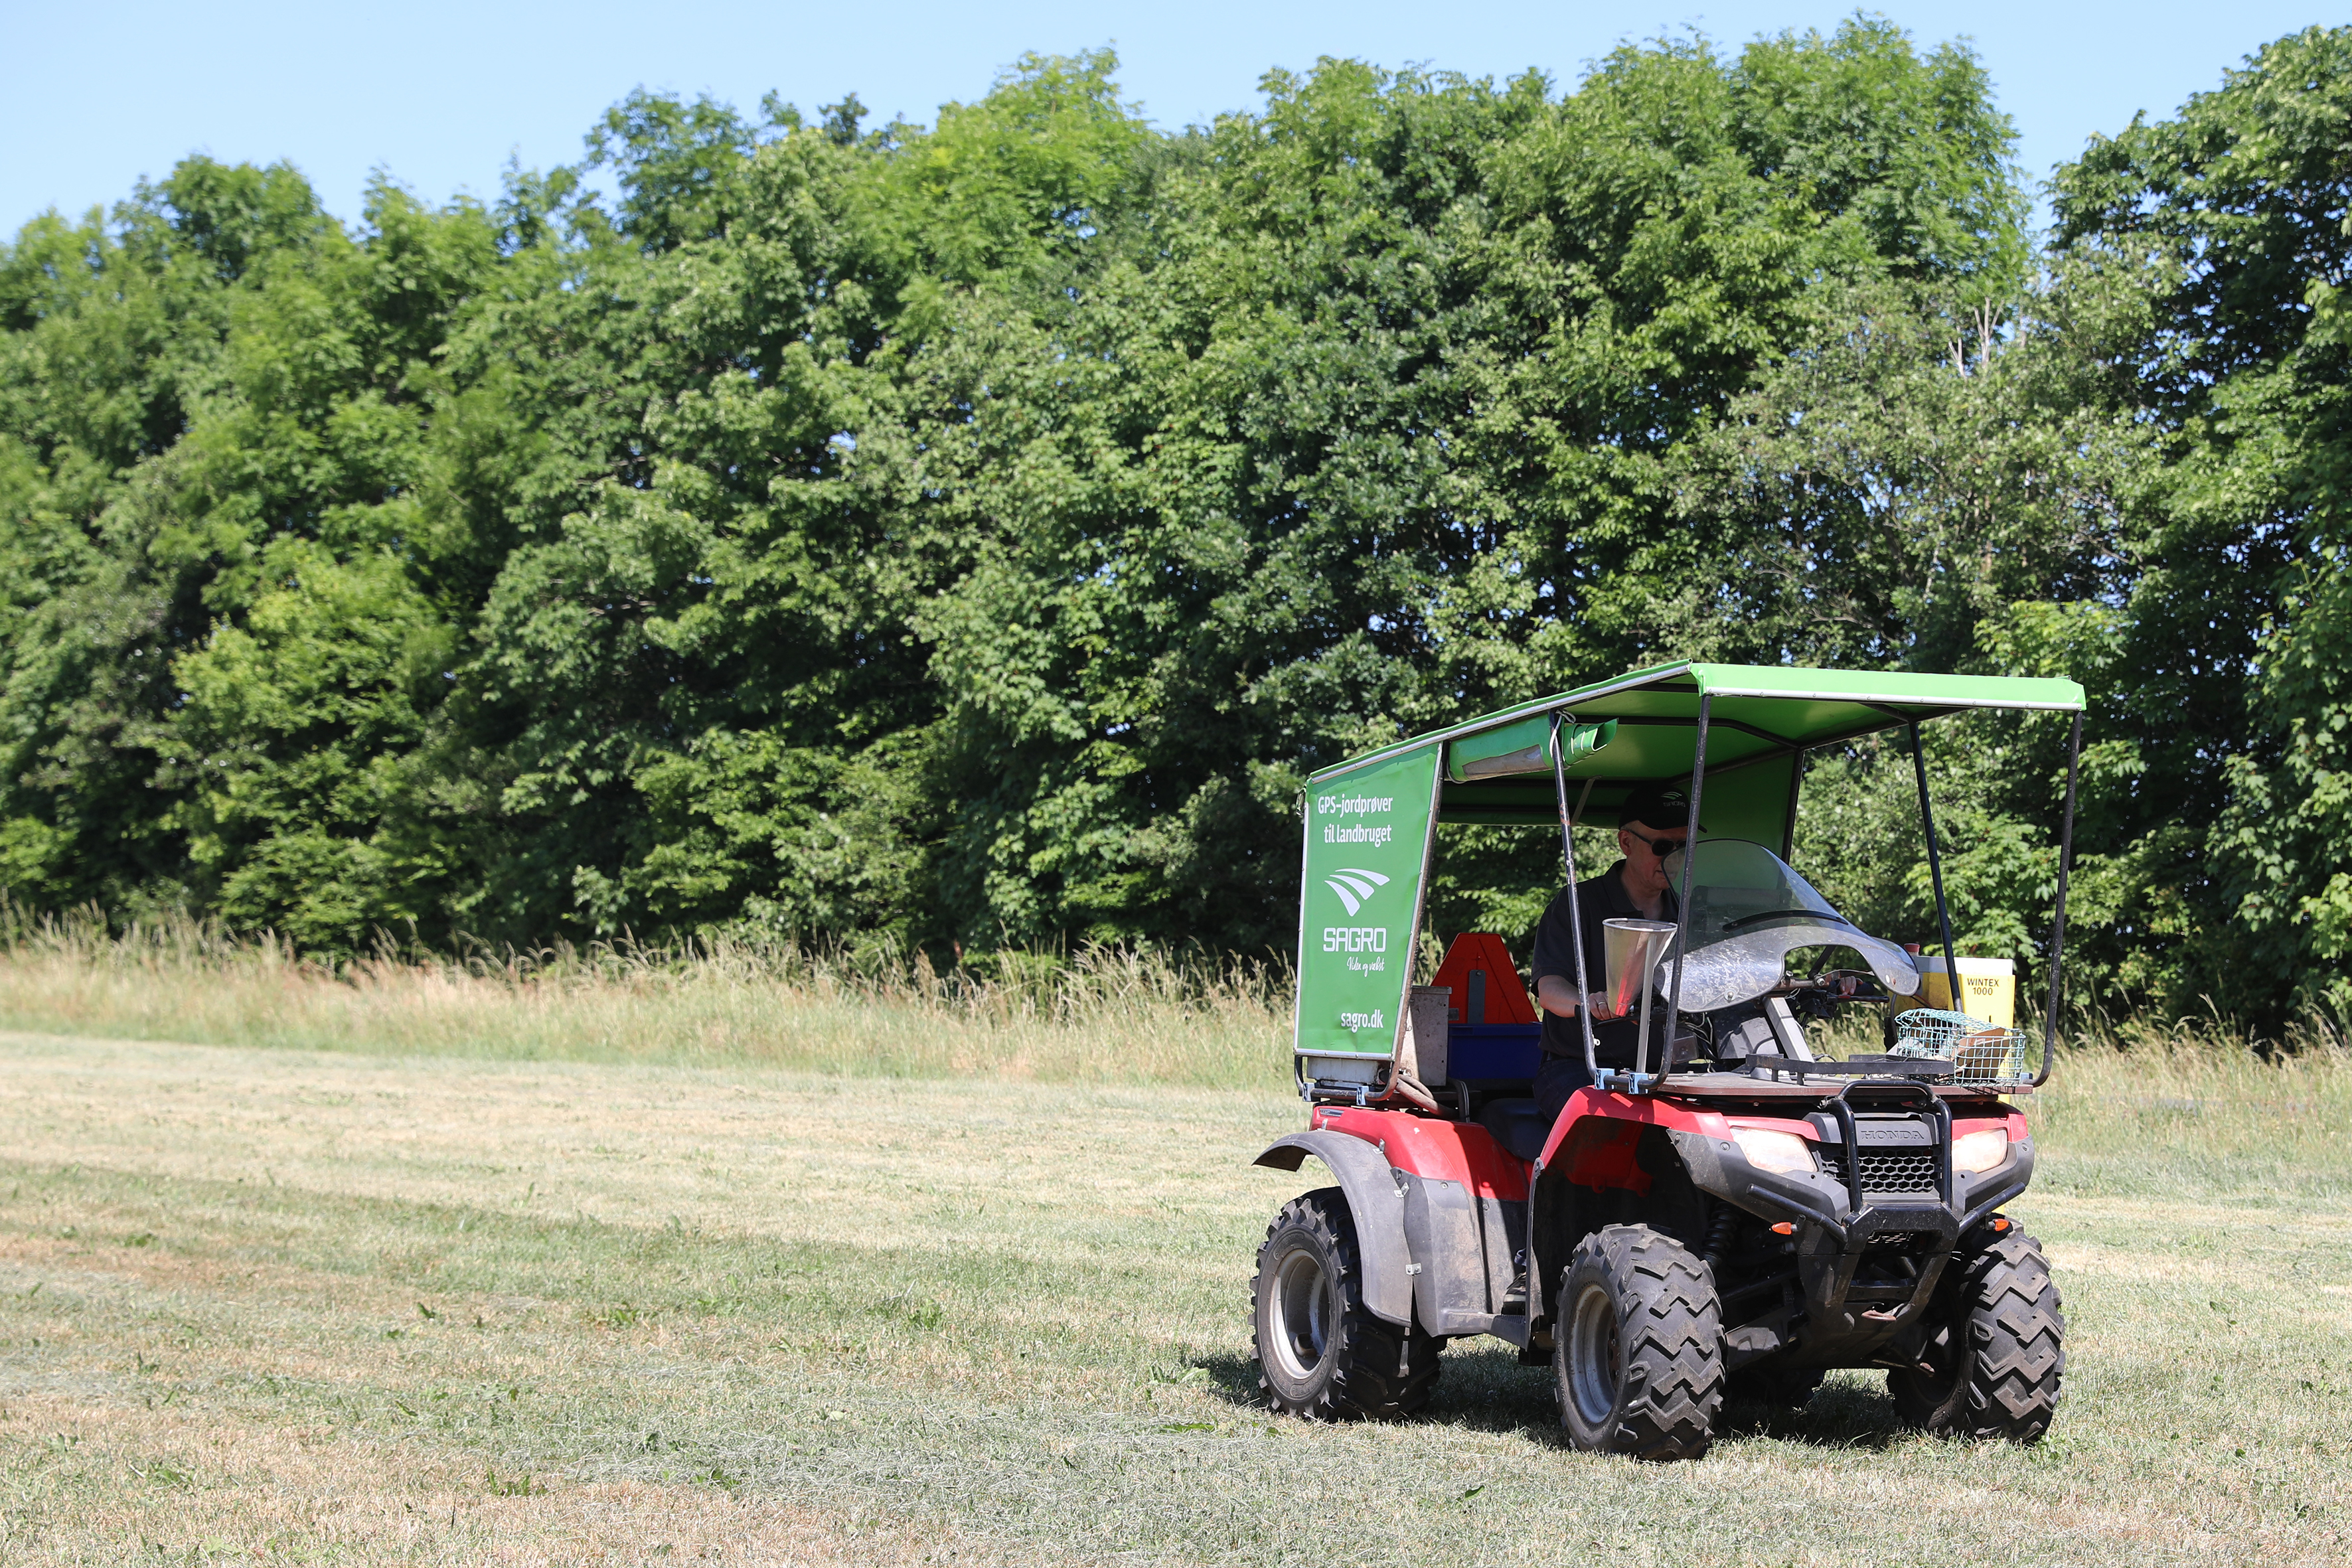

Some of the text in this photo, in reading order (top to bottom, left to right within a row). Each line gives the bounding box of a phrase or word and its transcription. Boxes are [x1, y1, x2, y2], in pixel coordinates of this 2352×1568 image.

[1318, 793, 1393, 818] GPS-jordprøver
[1324, 823, 1392, 848] til landbruget
[1323, 927, 1386, 952] SAGRO
[1346, 956, 1362, 971] Viden
[1362, 963, 1369, 978] og
[1967, 978, 1999, 987] WINTEX
[1972, 987, 1994, 996] 1000
[1340, 1008, 1384, 1033] sagro.dk
[1861, 1131, 1924, 1139] HONDA
